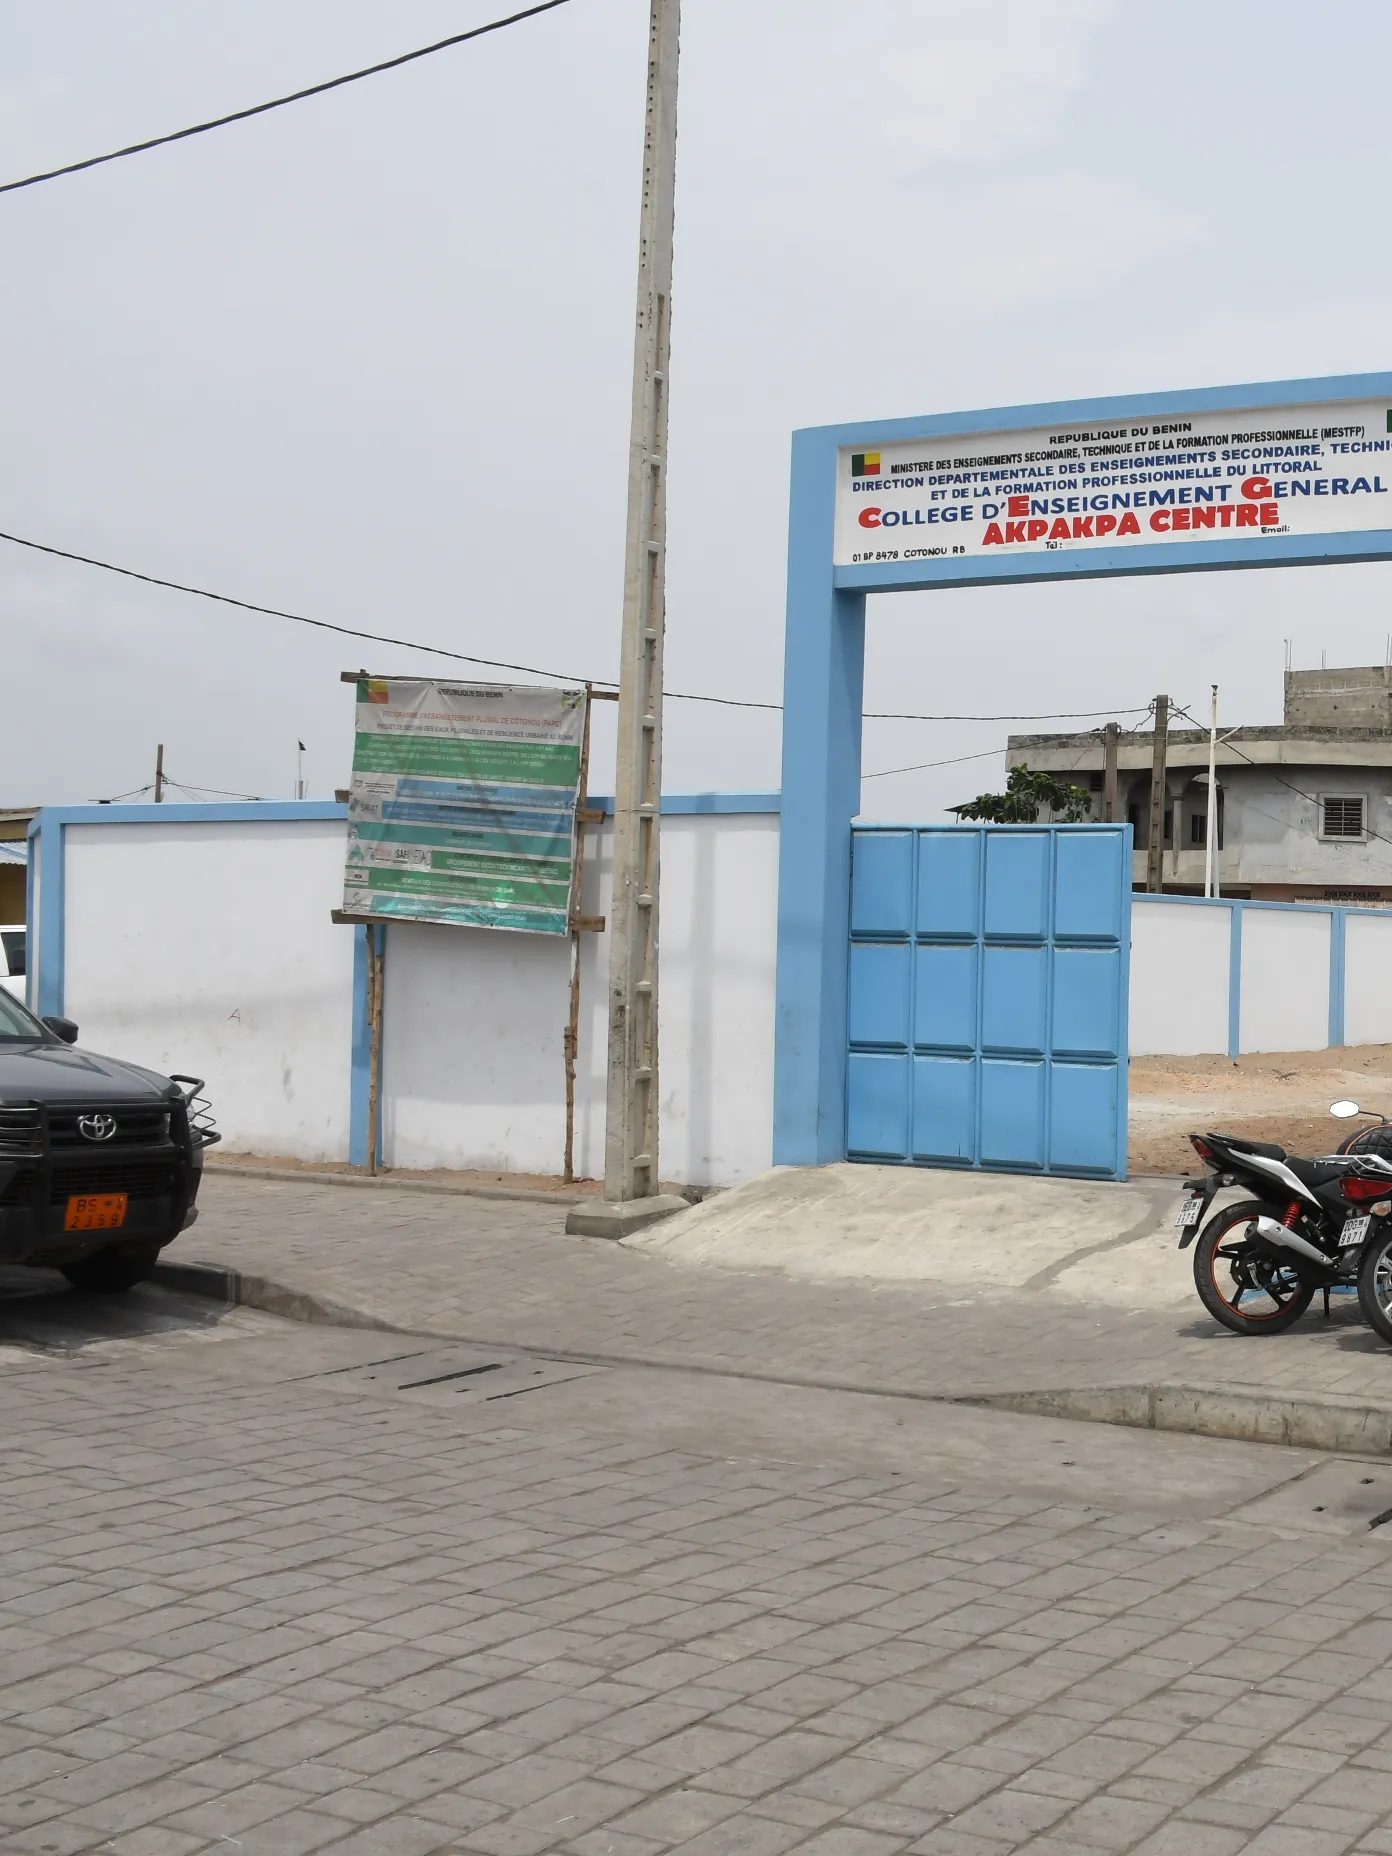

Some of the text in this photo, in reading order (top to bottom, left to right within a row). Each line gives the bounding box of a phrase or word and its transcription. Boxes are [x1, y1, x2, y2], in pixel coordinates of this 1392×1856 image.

[891, 426, 1365, 474] MINISTERE DES ENSEIGNEMENTS SECONDAIRE, TECHNIQUE ET DE LA FORMATION PROFESSIONNELLE (MESTFP)
[1050, 423, 1192, 444] REPUBLIQUE DU BENIN
[852, 477, 924, 492] DIRECTION
[929, 465, 1054, 486] DEPARTEMENTALE
[1059, 462, 1086, 475] DES
[1091, 451, 1216, 472] ENSEIGNEMENTS
[1221, 445, 1325, 461] SECONDAIRE,
[931, 461, 1322, 501] ET DE LA FORMATION PROFESSIONNELLE DU LITTORAL
[858, 505, 973, 529] COLLEGE
[982, 485, 1232, 520] D'ENSEIGNEMENT
[1241, 476, 1388, 500] GENERAL
[982, 503, 1279, 546] AKPAKPA CENTRE
[853, 545, 966, 562] 01 BP 8478 COTONOU RB
